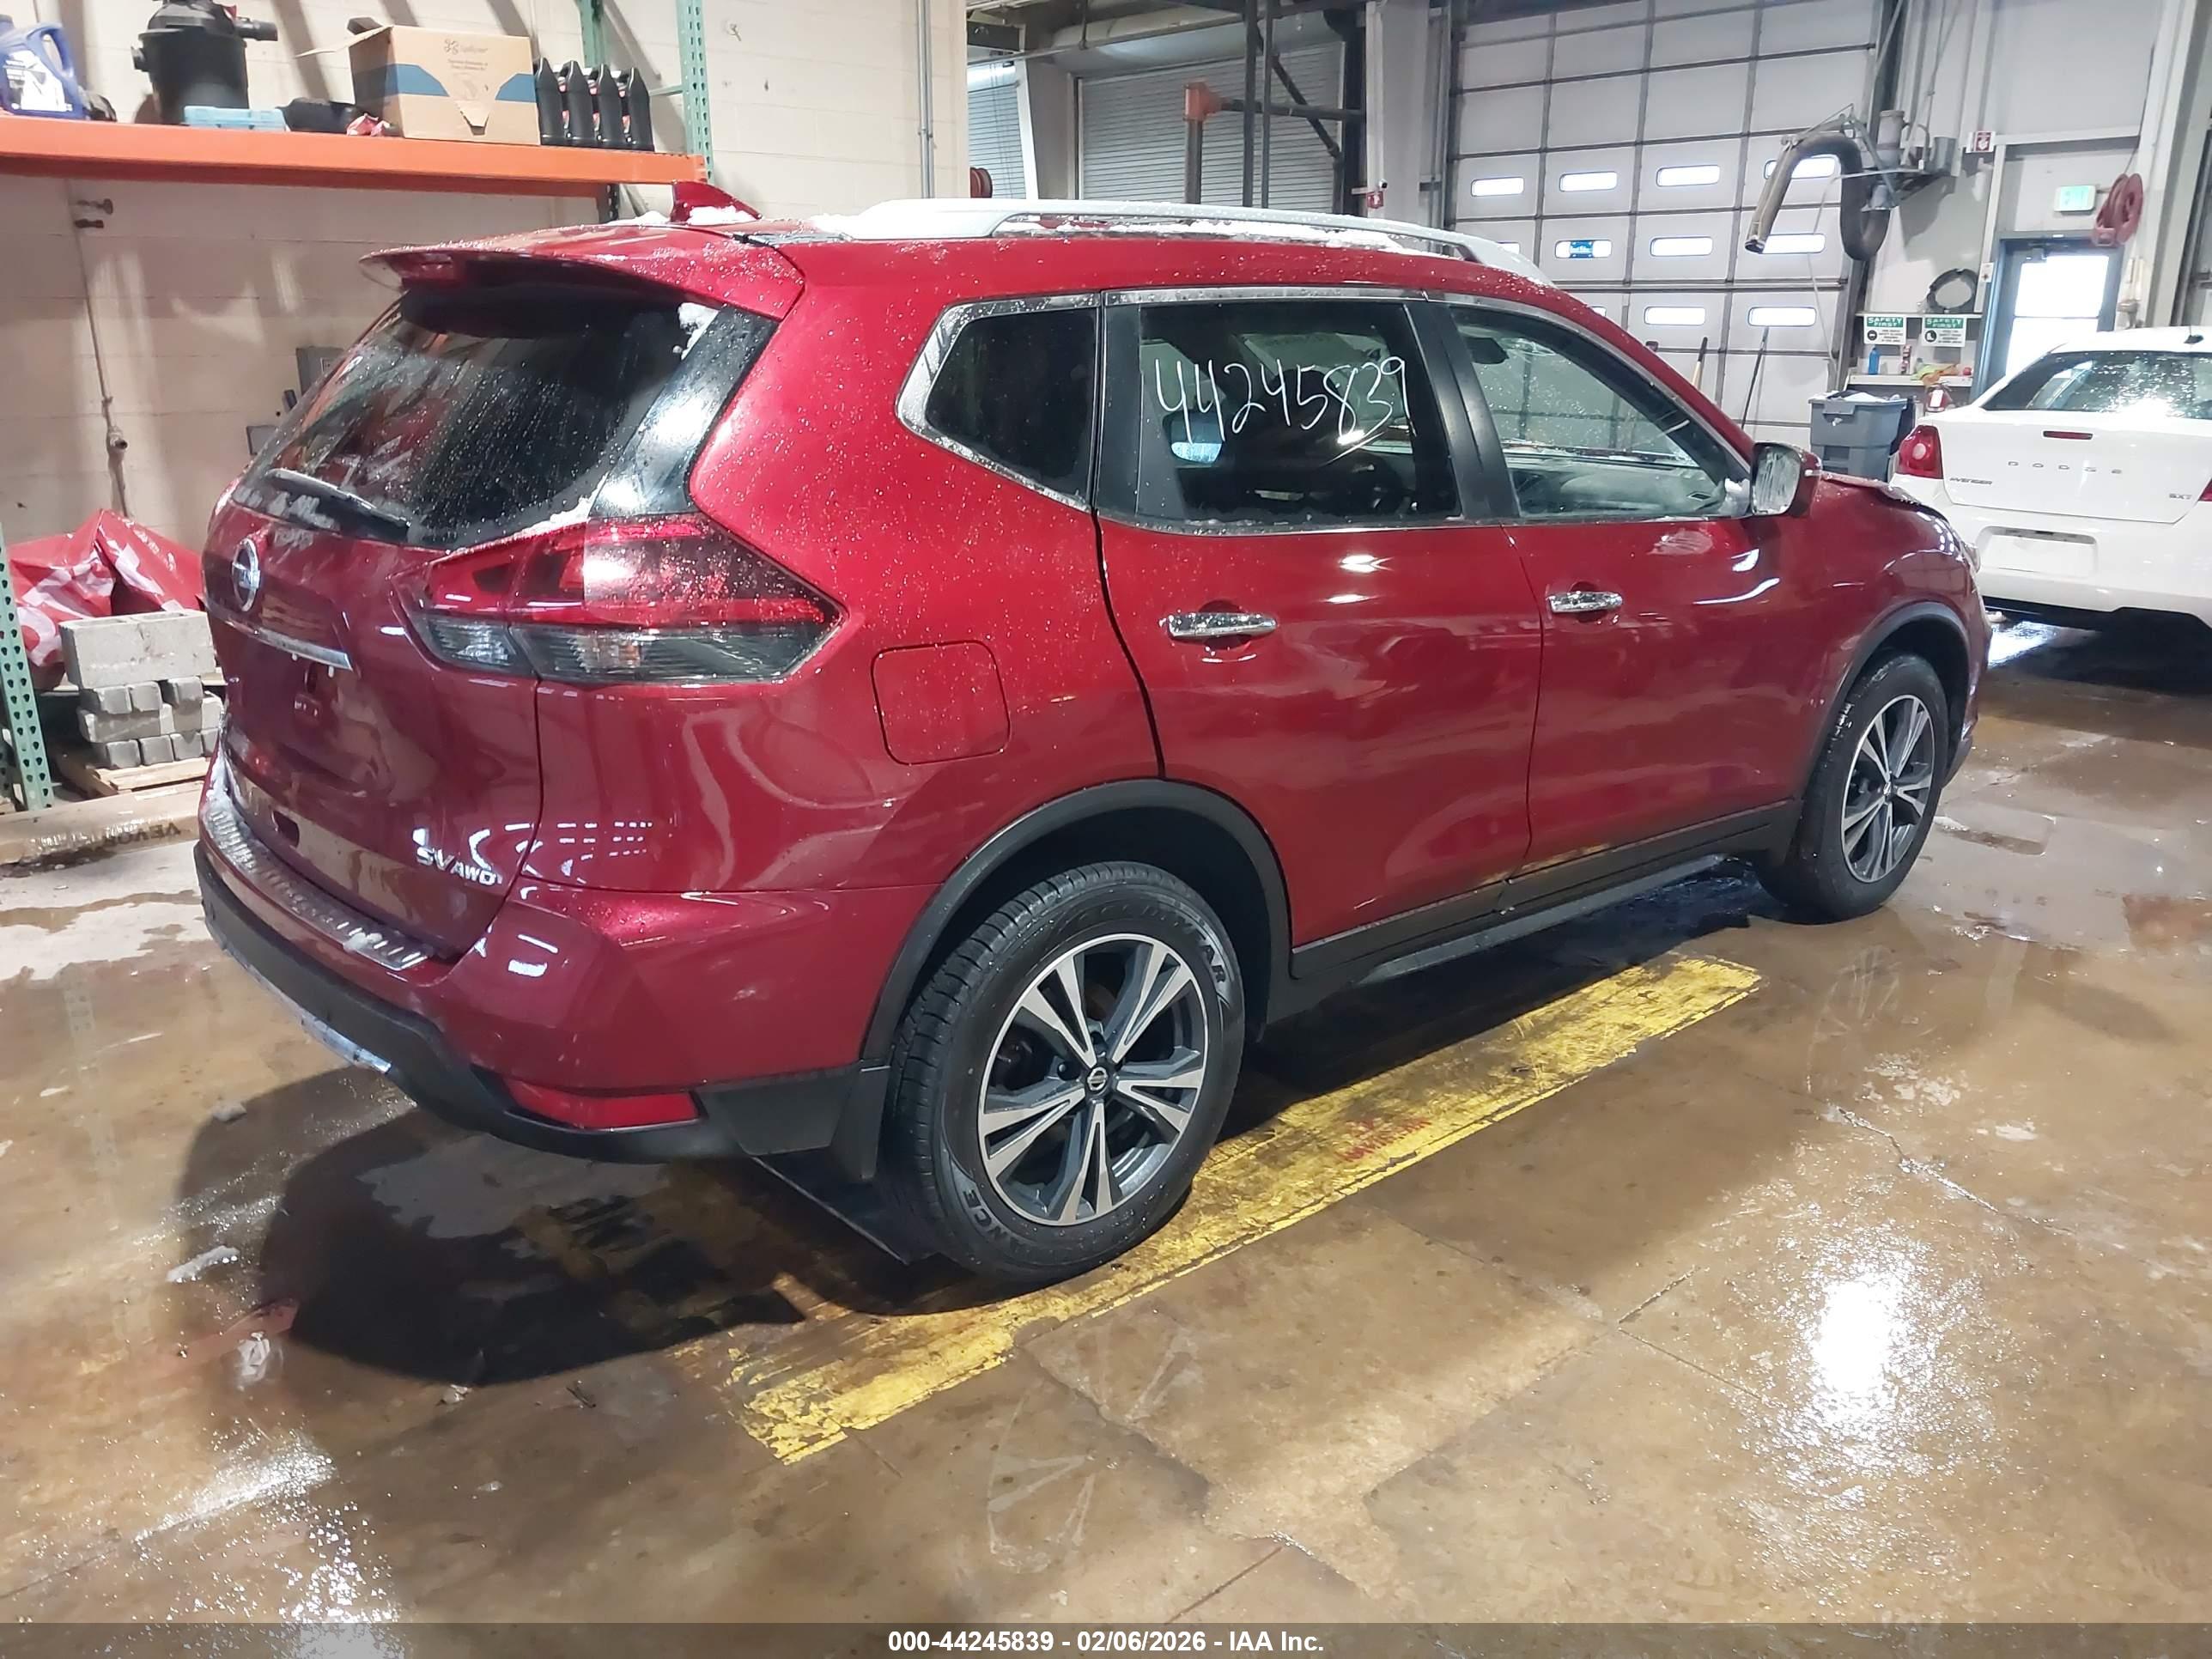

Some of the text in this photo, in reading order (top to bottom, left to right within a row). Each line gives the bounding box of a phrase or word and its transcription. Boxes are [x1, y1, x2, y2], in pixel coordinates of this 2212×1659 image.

[1155, 356, 1416, 445] 44245839
[2008, 461, 2123, 474] DODGE
[416, 847, 496, 886] SV AWD
